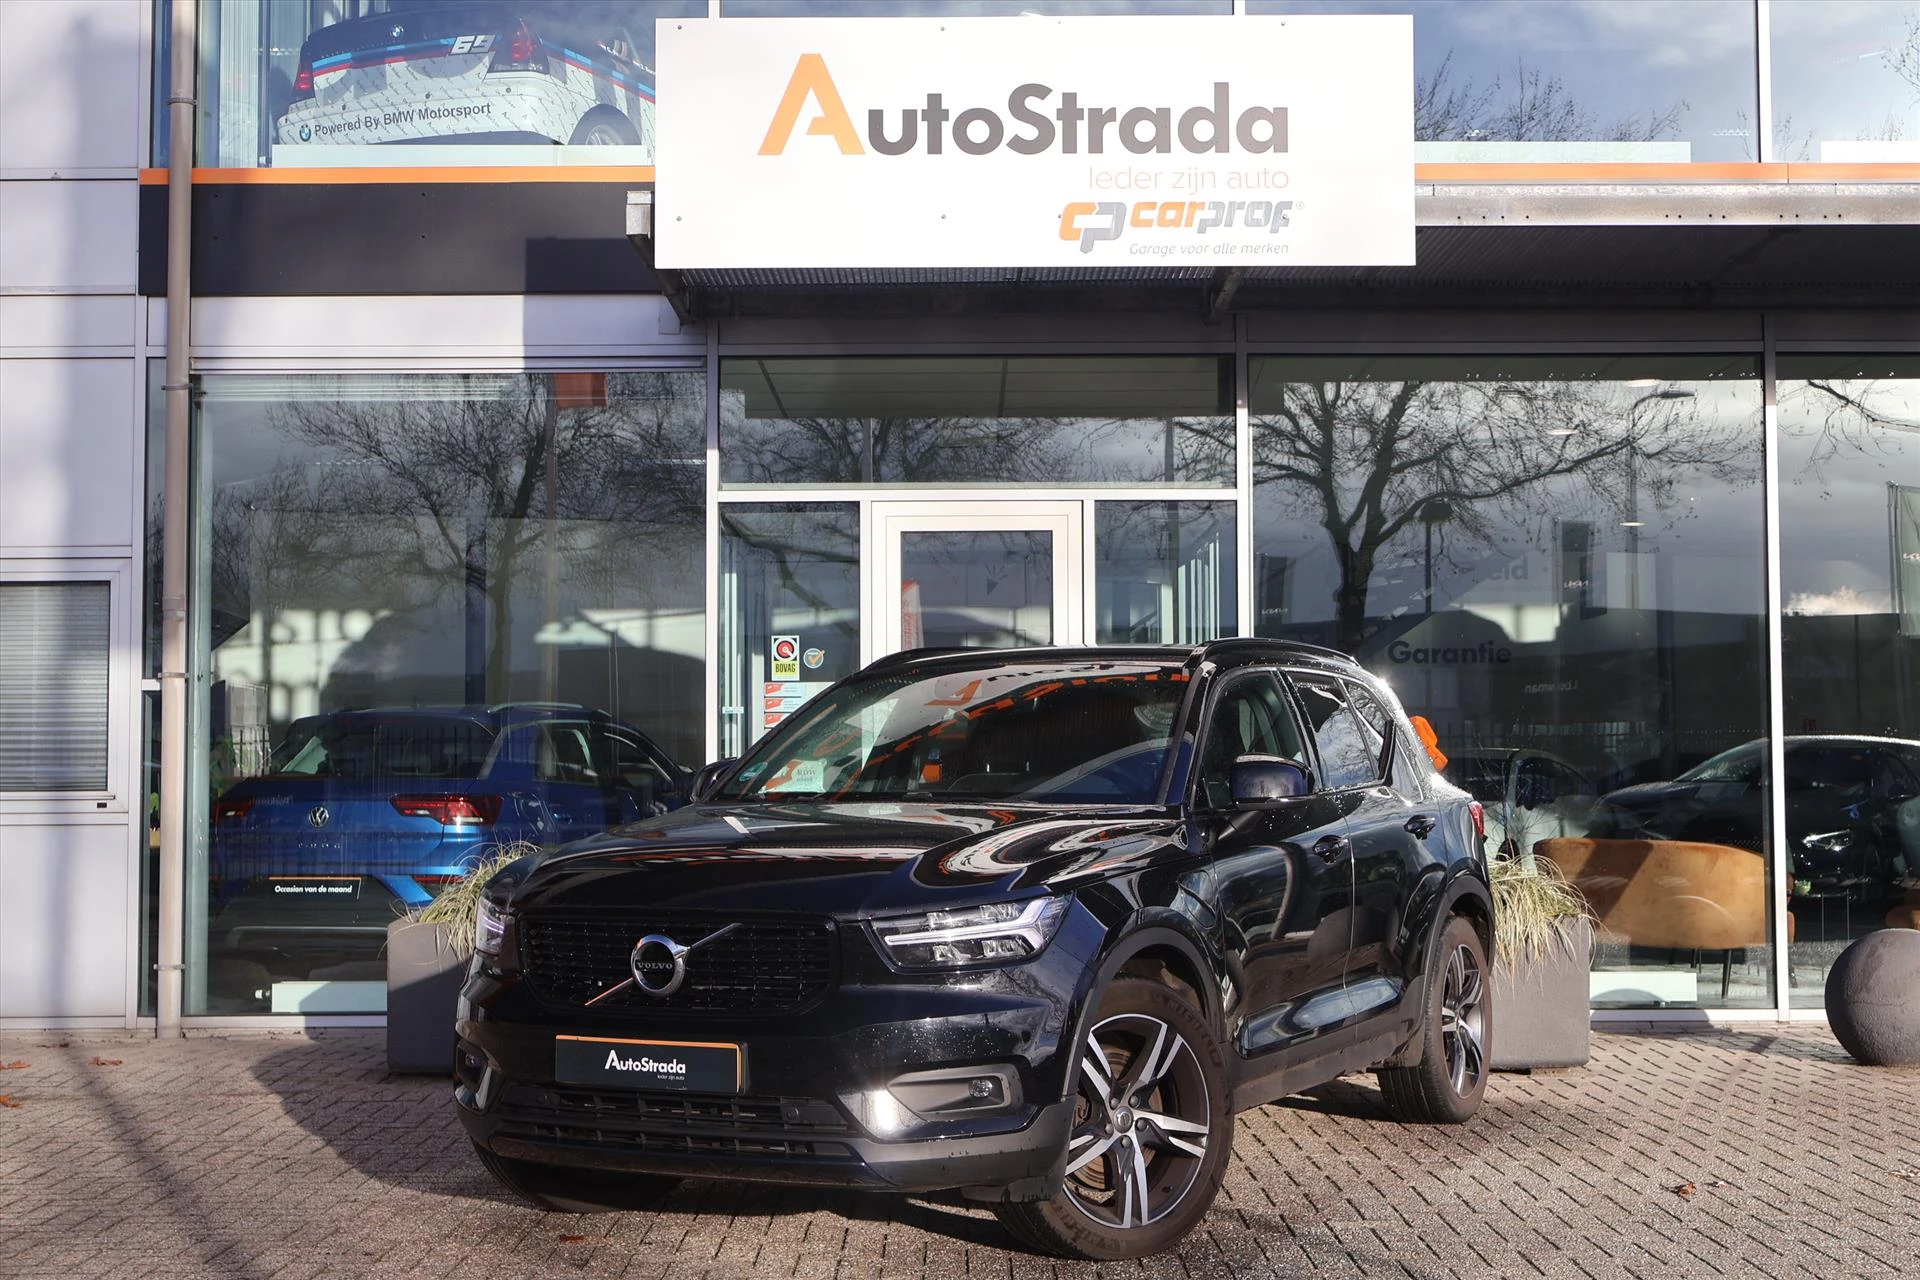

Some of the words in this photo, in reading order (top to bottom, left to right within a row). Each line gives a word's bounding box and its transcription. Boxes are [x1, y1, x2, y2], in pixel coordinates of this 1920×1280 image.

[453, 34, 495, 56] 69
[757, 53, 1288, 156] AutoStrada
[314, 119, 361, 136] Powered
[364, 113, 380, 131] By
[383, 109, 415, 126] BMW
[417, 102, 491, 121] Motorsport
[1088, 166, 1161, 190] Ieder
[1172, 166, 1216, 195] zijn
[1226, 167, 1289, 189] auto
[1129, 200, 1293, 234] carprof
[1129, 242, 1176, 257] Garage
[1180, 243, 1209, 255] voor
[1213, 242, 1236, 255] alle
[1240, 242, 1289, 254] merken
[1388, 640, 1513, 664] Garantie
[775, 663, 796, 673] BOVAG
[274, 885, 303, 893] Occasion
[304, 885, 316, 893] van
[318, 884, 327, 893] de
[327, 885, 353, 893] maand
[637, 962, 673, 970] VOLVO
[604, 1049, 686, 1074] AutoStrada
